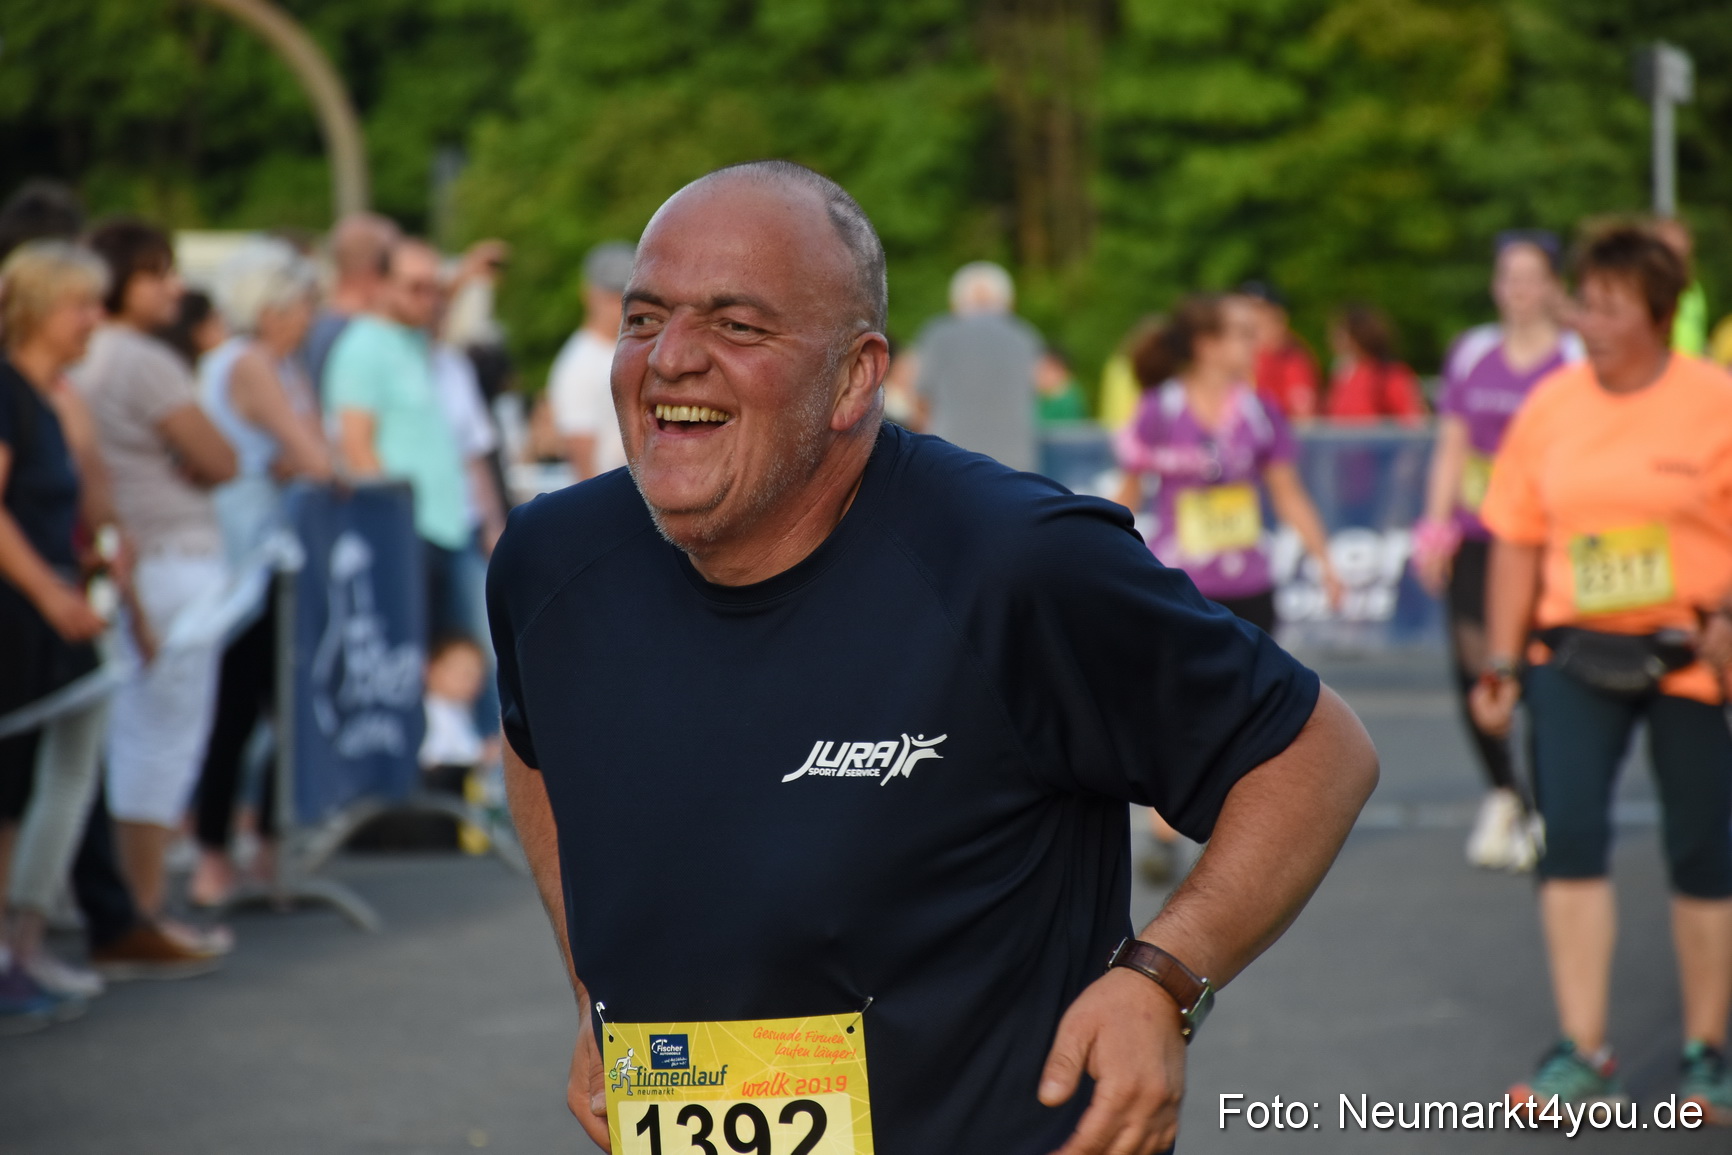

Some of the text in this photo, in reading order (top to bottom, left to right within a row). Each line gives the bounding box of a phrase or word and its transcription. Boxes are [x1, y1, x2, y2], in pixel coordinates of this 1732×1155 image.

[782, 741, 900, 783] JURA
[808, 767, 881, 777] SPORT SERVICE
[753, 1027, 845, 1045] Gesunde Firmen
[656, 1044, 684, 1052] Fischer
[775, 1044, 857, 1065] laufen länger!
[636, 1065, 728, 1086] firmenlauf
[741, 1072, 848, 1098] walk 2019
[637, 1087, 675, 1096] neumarkt
[635, 1099, 828, 1155] 1392
